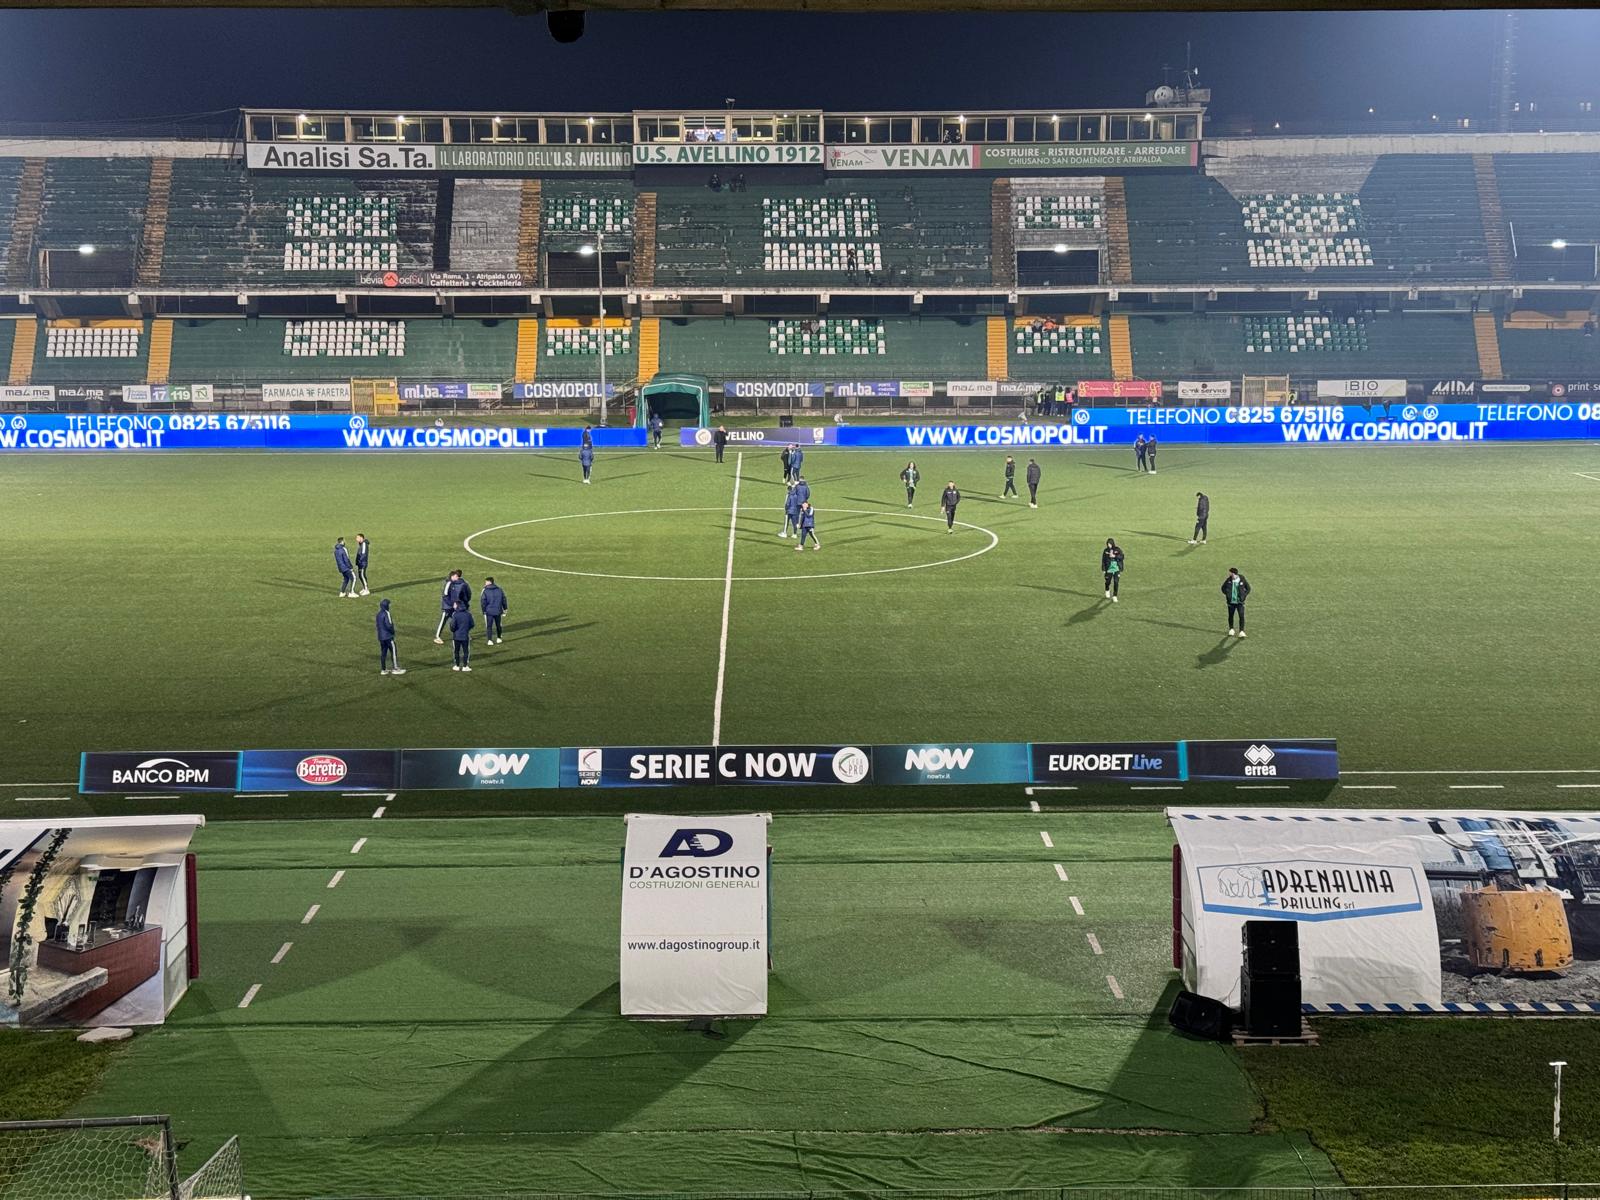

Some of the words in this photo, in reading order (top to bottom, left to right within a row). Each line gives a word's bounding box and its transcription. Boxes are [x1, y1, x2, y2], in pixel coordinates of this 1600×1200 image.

[263, 146, 349, 167] Analisi
[358, 147, 432, 168] Sa.Ta.
[440, 151, 449, 166] IL
[452, 151, 524, 166] LABORATORIO
[579, 152, 631, 166] AVELLINO
[636, 146, 672, 163] U.S.
[676, 146, 770, 163] AVELLINO
[775, 146, 821, 162] 1912
[881, 148, 969, 167] VENAM
[985, 148, 1039, 157] COSTRUIRE
[1048, 147, 1126, 156] RISTRUTTURARE
[1134, 146, 1186, 155] ARREDARE
[830, 158, 863, 168] VENAM
[1008, 156, 1050, 165] CHIUSANO
[1052, 156, 1068, 165] SAN
[1070, 156, 1115, 164] DOMENICO
[1117, 156, 1121, 164] E
[1122, 155, 1162, 163] ATRIPALDA
[263, 388, 304, 398] FARMACIA
[317, 387, 349, 397] FARETRA
[524, 383, 603, 398] COSMOPOL
[736, 382, 813, 397] COSMOPOL
[1568, 382, 1600, 392] print-s
[152, 391, 166, 400] 17
[170, 391, 190, 400] 119
[1127, 409, 1220, 424] TELEFONO
[1280, 407, 1344, 423] 675116
[1477, 405, 1573, 421] TELEFONO
[168, 415, 220, 430] 0825
[225, 415, 291, 429] 675116
[343, 428, 547, 447] WWW.COSMOPOL.IT
[725, 431, 764, 441] VELLINO
[906, 426, 1108, 445] WWW.COSMOPOL.IT
[1281, 422, 1488, 441] WWW.COSMOPOL.IT
[458, 753, 530, 776] NOW
[629, 754, 710, 779] SERIE
[718, 753, 737, 778] C
[745, 753, 817, 777] NOW
[904, 748, 974, 770] NOW
[112, 769, 173, 784] BANCO
[176, 768, 209, 783] BPM
[299, 760, 345, 777] Beretta
[848, 766, 863, 775] PRO
[630, 866, 760, 878] D'AGOSTINO
[629, 881, 703, 889] COSTRUZIONI
[706, 880, 760, 889] GENERALI
[1263, 869, 1394, 893] ADRENALINA
[1281, 896, 1341, 909] DRILLING
[1344, 901, 1355, 909] srl
[628, 939, 760, 952] www.dagostinogroup.it
